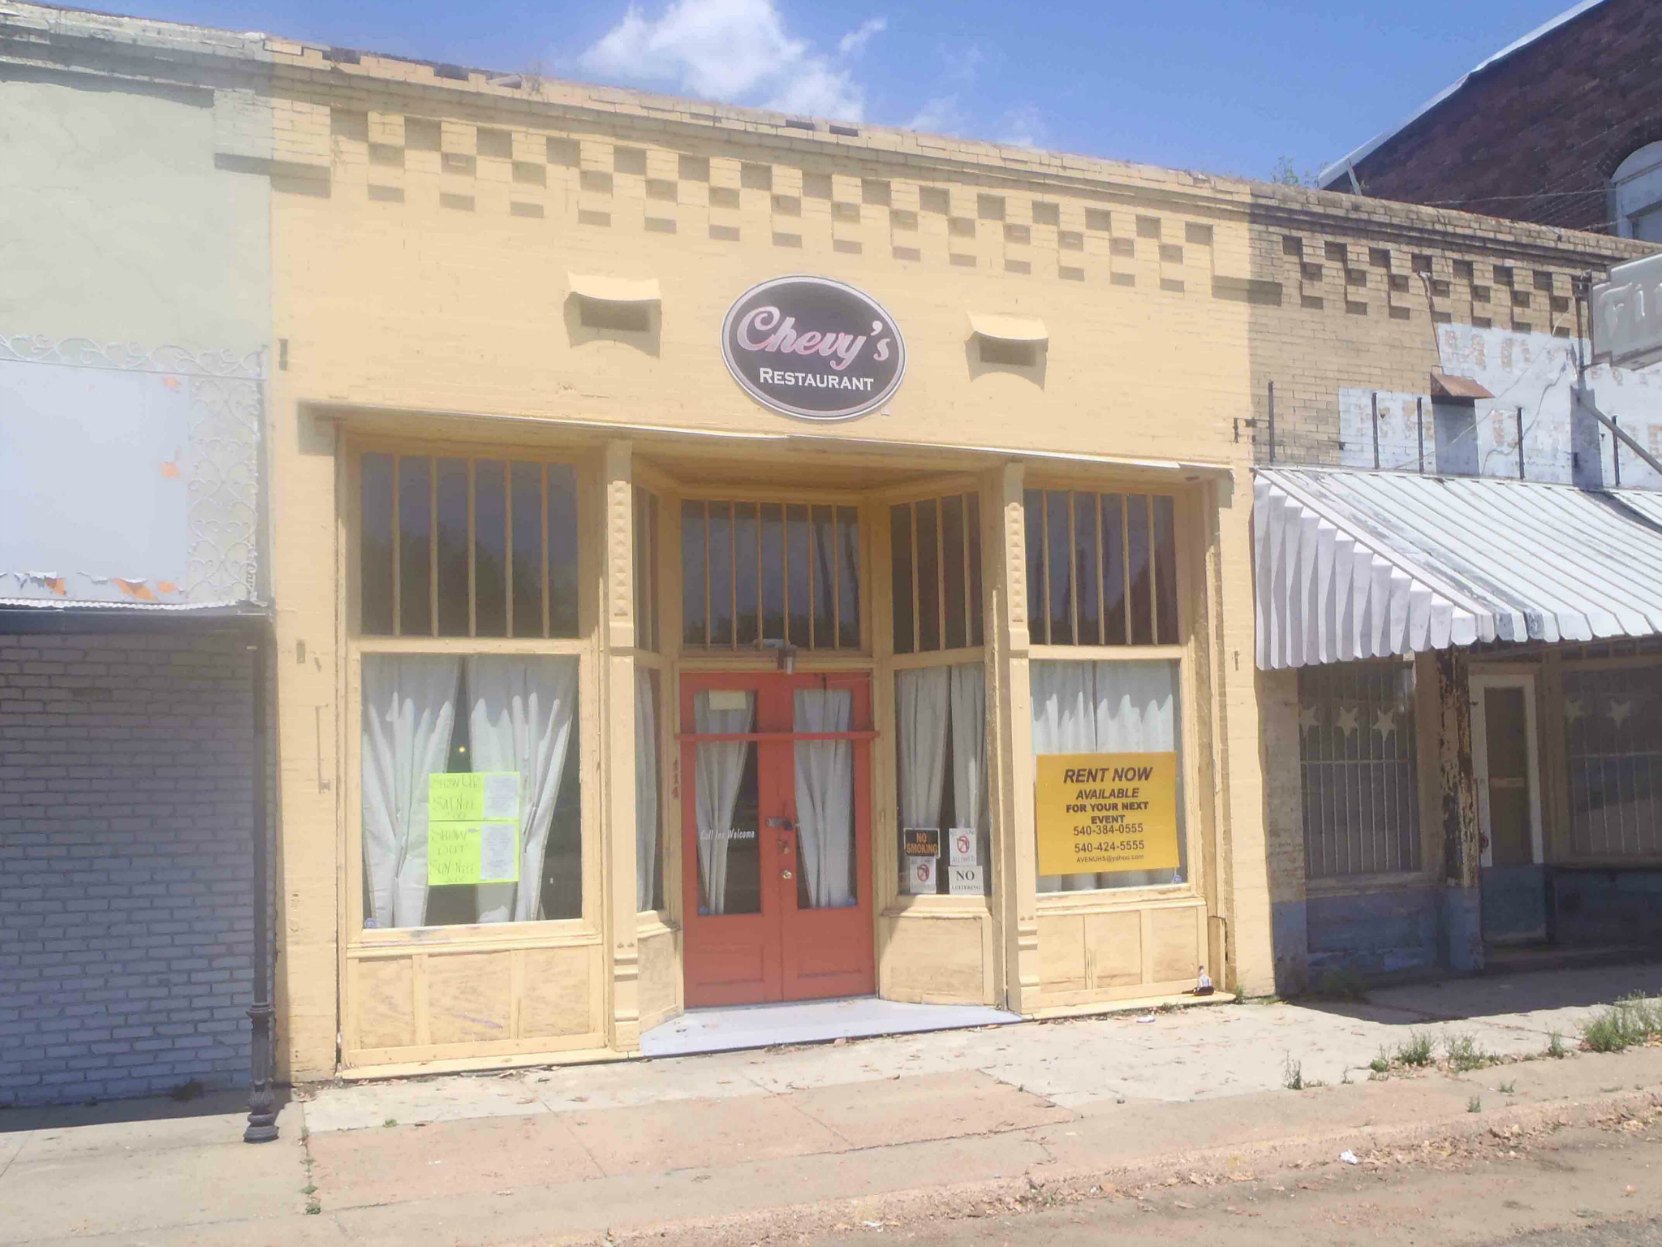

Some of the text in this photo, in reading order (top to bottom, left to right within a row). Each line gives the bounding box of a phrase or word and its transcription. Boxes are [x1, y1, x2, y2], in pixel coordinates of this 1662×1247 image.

[737, 305, 891, 370] Chevy's
[759, 367, 874, 391] RESTAURANT
[1063, 766, 1153, 784] RENT NOW
[1076, 788, 1140, 800] AVAILABLE
[1066, 801, 1149, 813] FOR YOUR NEXT
[1090, 814, 1126, 825] EVENT
[1073, 823, 1144, 836] 540-384-0555
[916, 832, 927, 842] NO
[906, 843, 938, 854] SMOKING
[1074, 840, 1144, 853] 540-424-5555
[956, 870, 975, 881] NO
